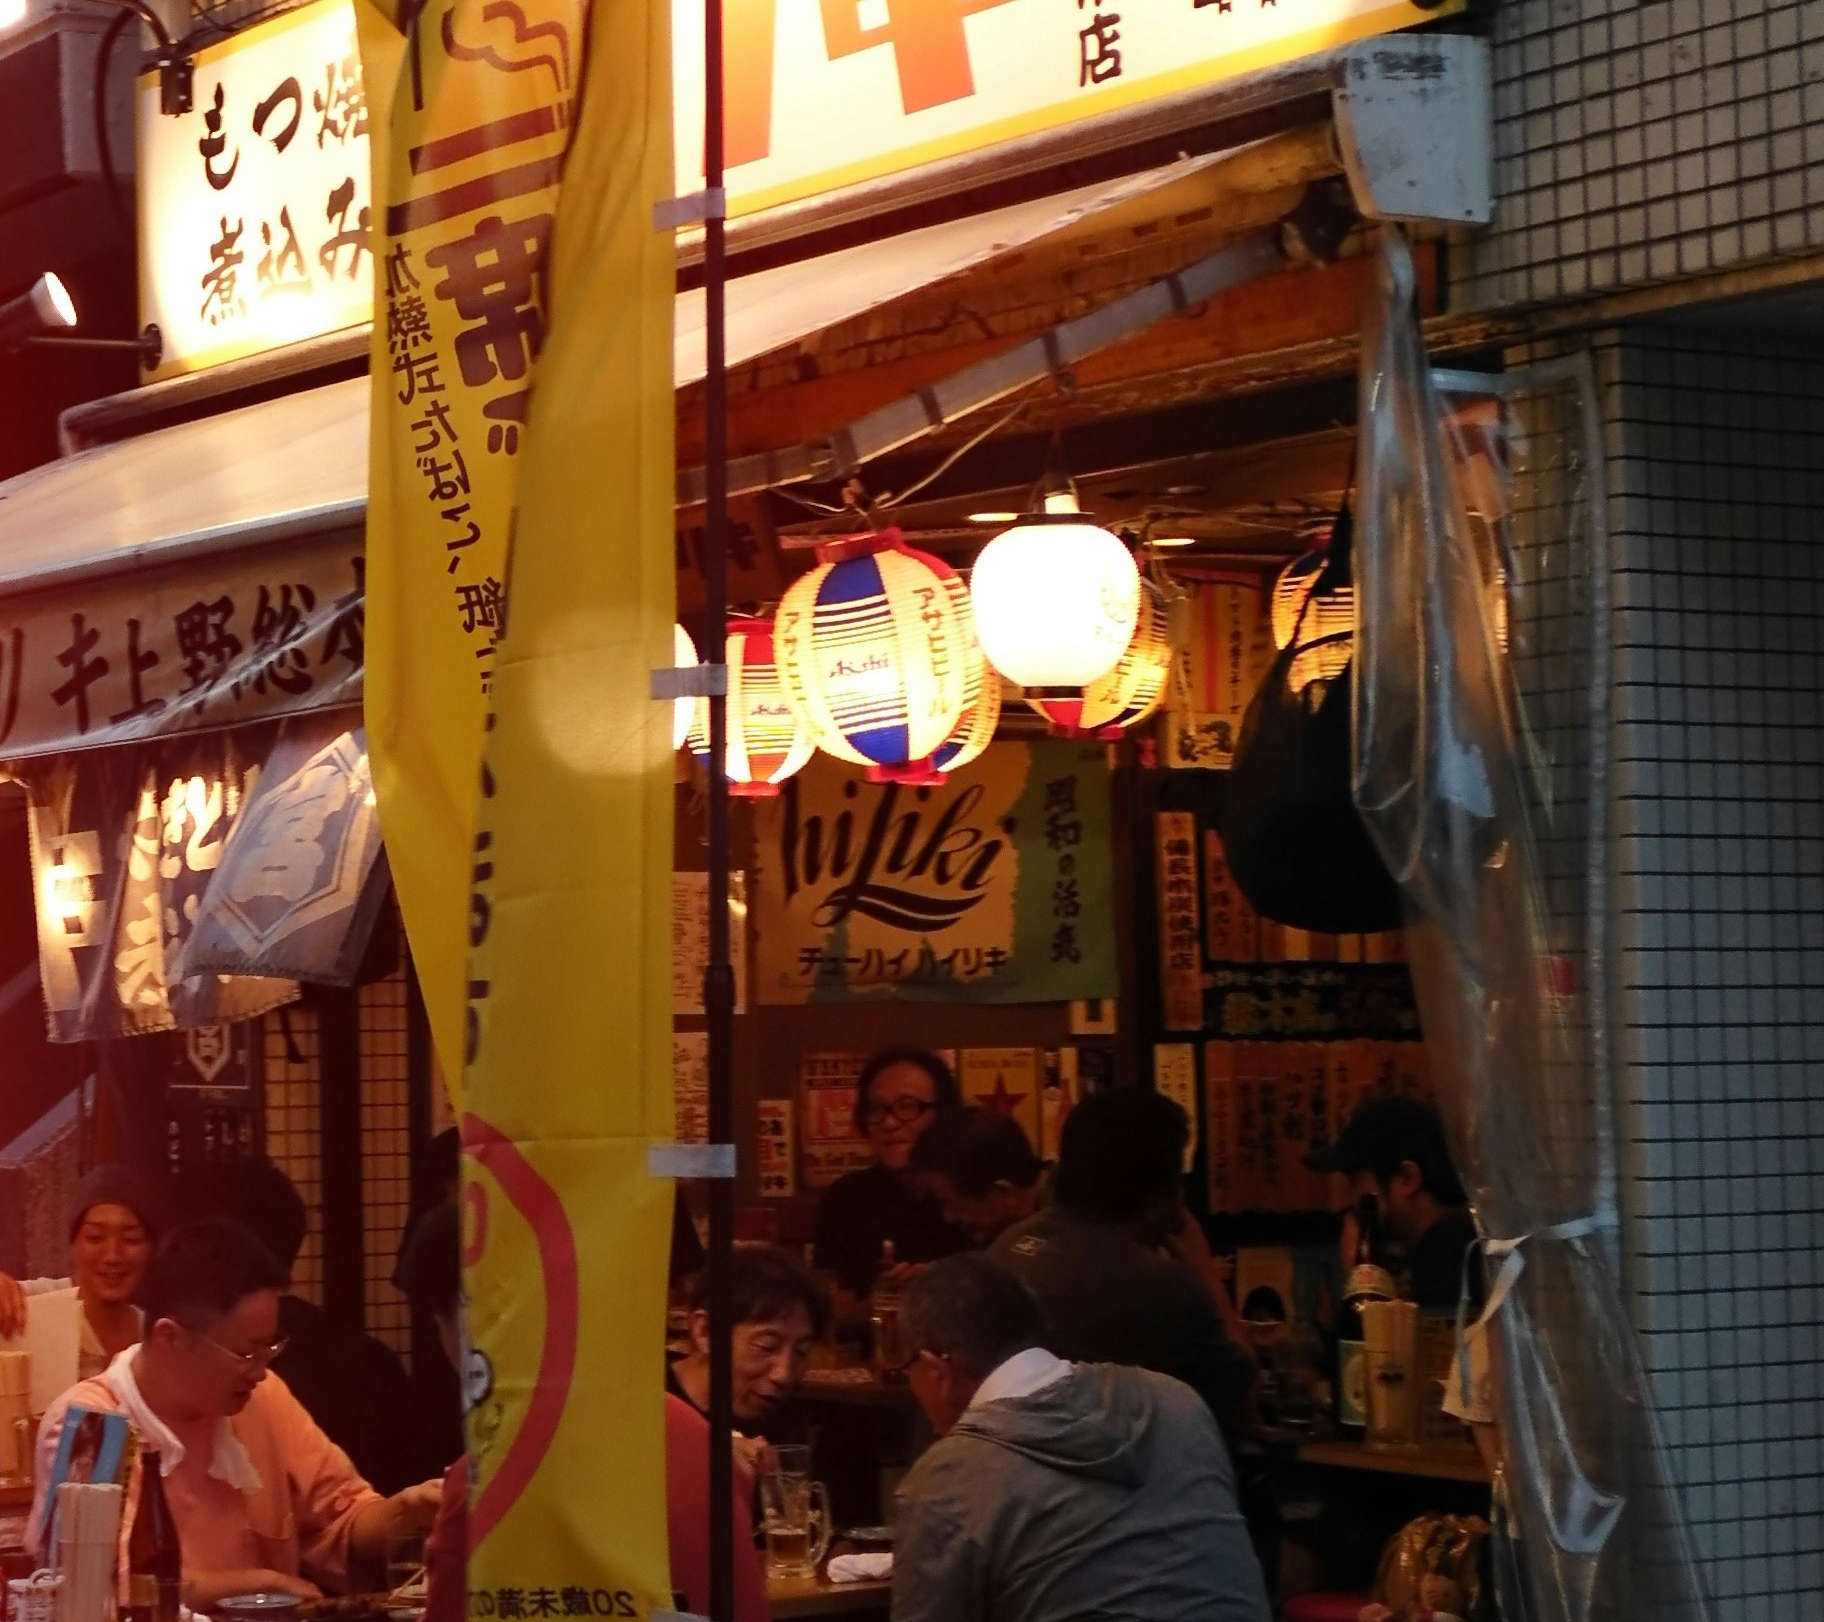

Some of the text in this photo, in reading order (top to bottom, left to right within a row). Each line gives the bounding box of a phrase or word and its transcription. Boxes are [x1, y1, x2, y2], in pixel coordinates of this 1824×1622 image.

[198, 63, 370, 191] もつ焼
[200, 175, 373, 327] 煮込み
[829, 652, 890, 679] Asahi
[1043, 775, 1082, 965] 昭和の活気
